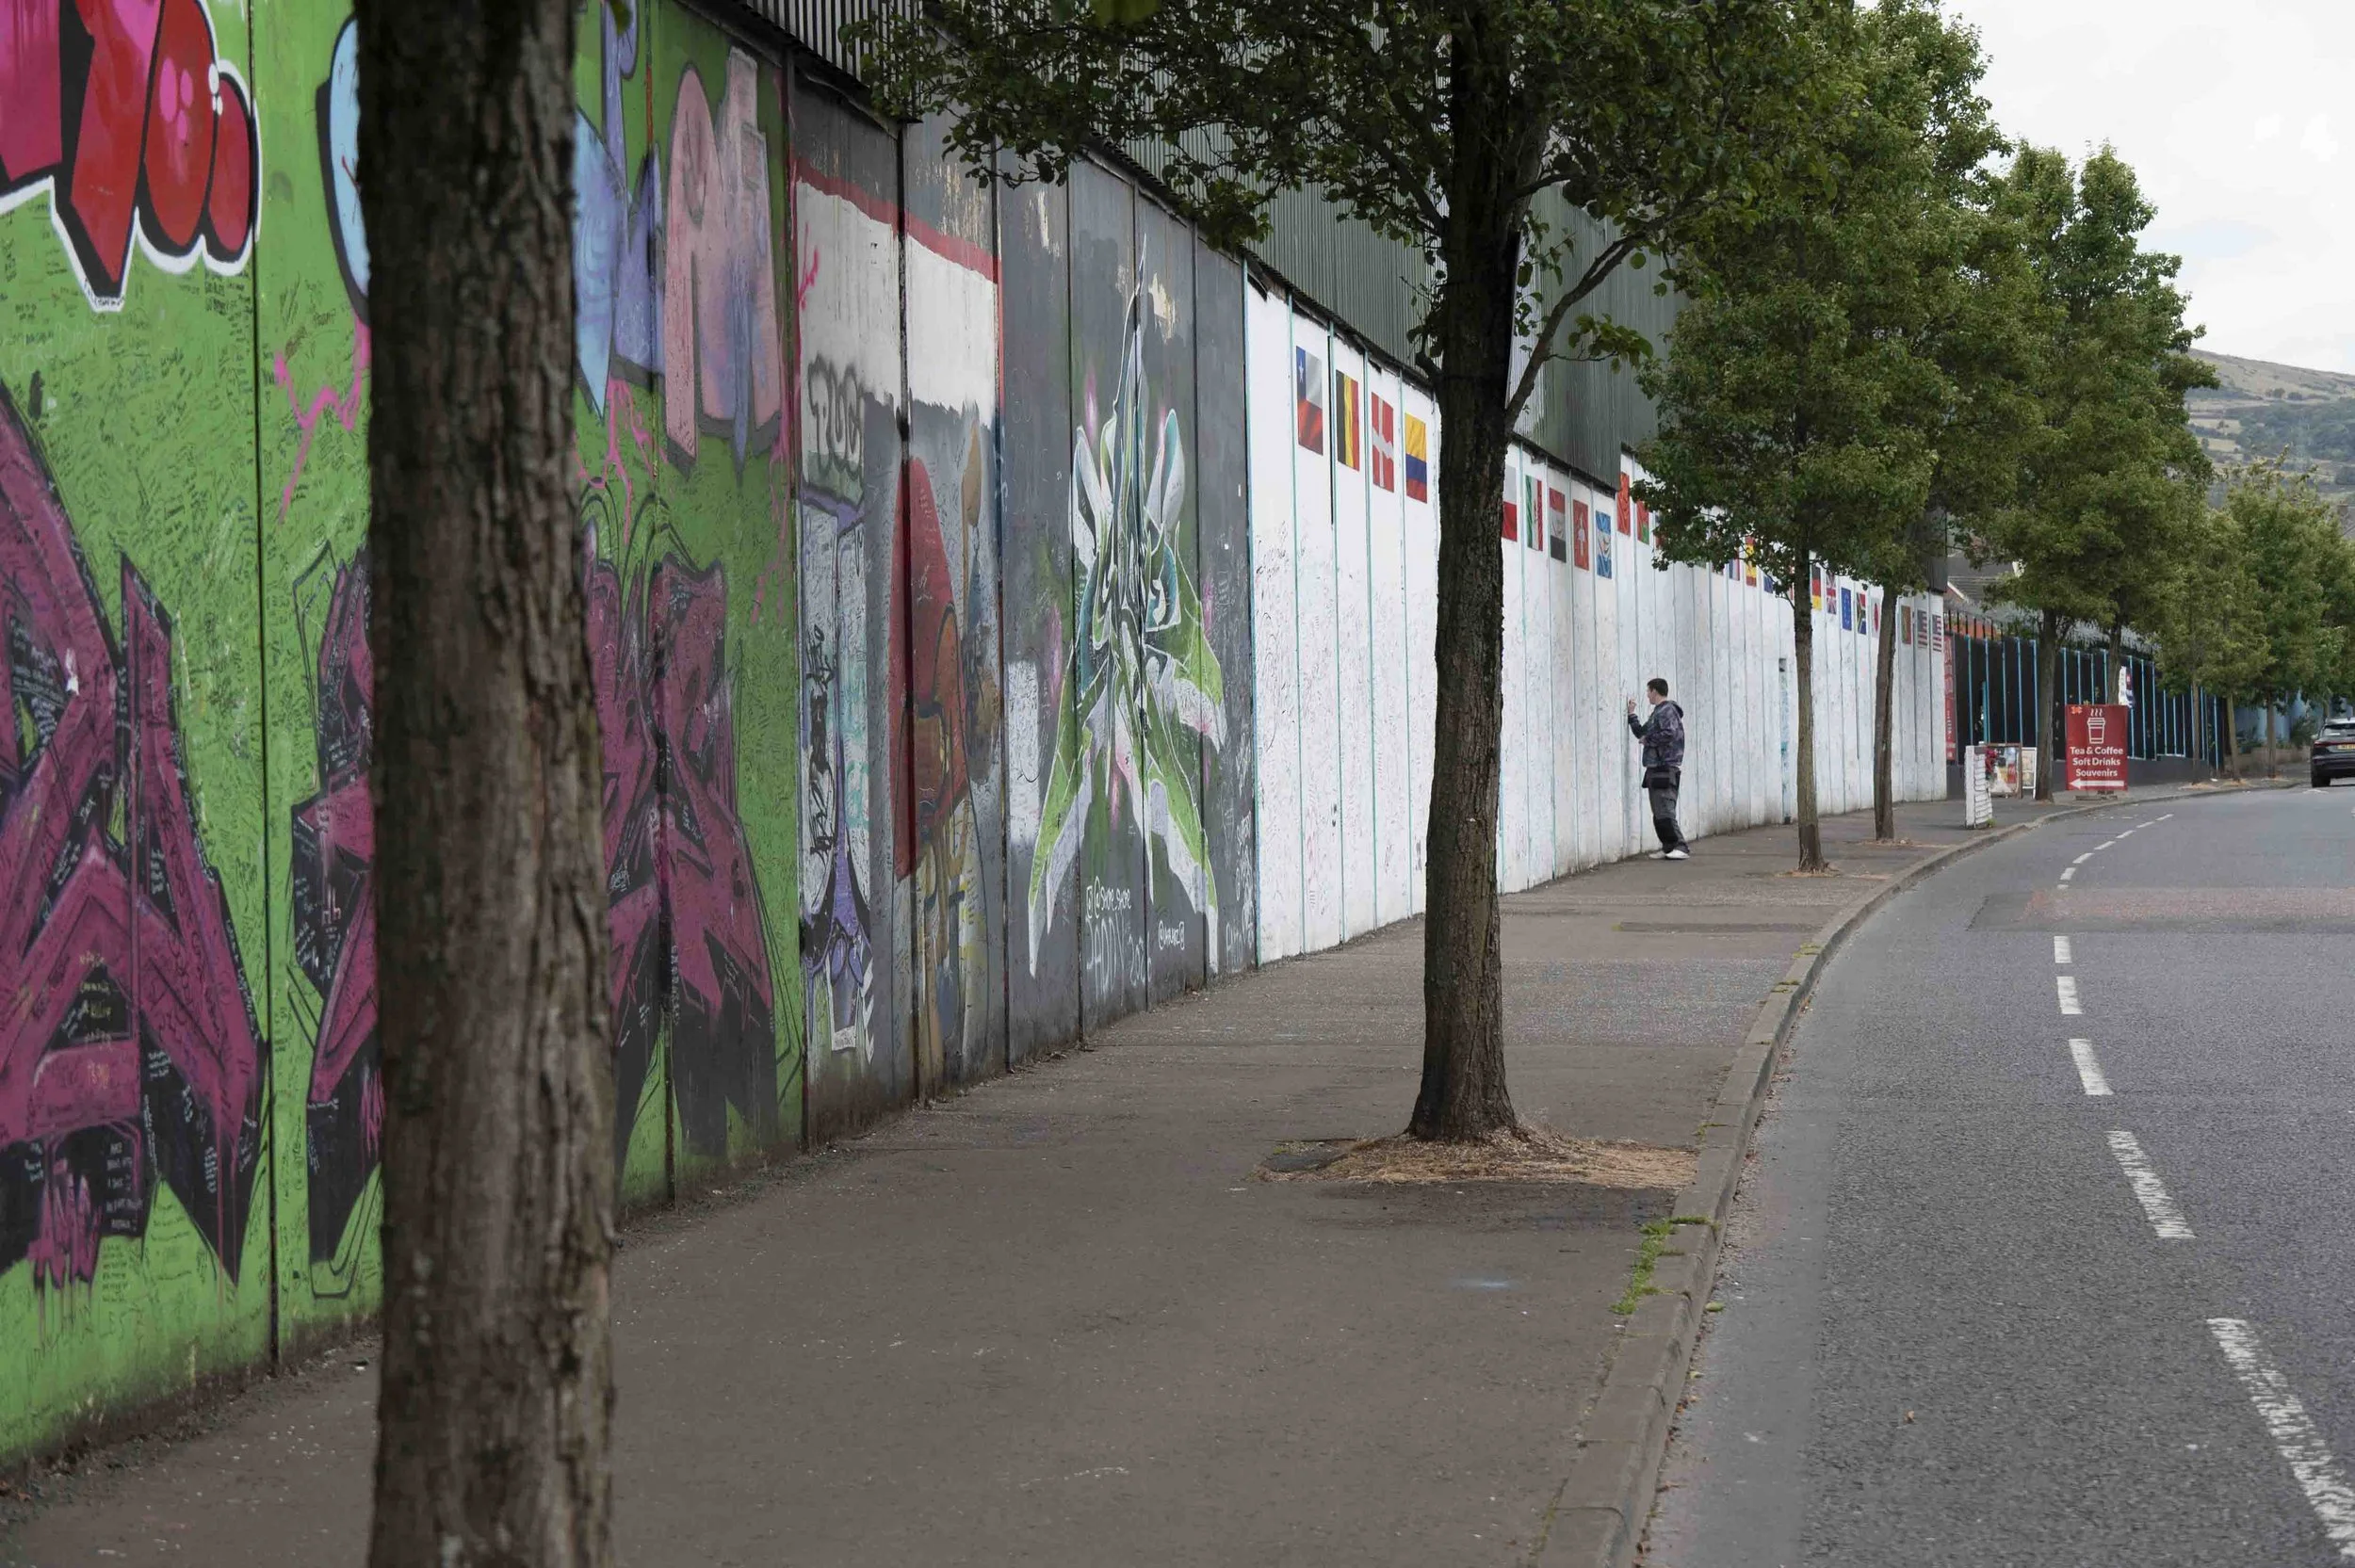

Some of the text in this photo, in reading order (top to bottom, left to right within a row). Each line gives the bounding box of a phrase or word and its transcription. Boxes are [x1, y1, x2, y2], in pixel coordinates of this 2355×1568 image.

[2072, 757, 2121, 766] Soft Drinks
[2075, 768, 2119, 777] Souvenirs
